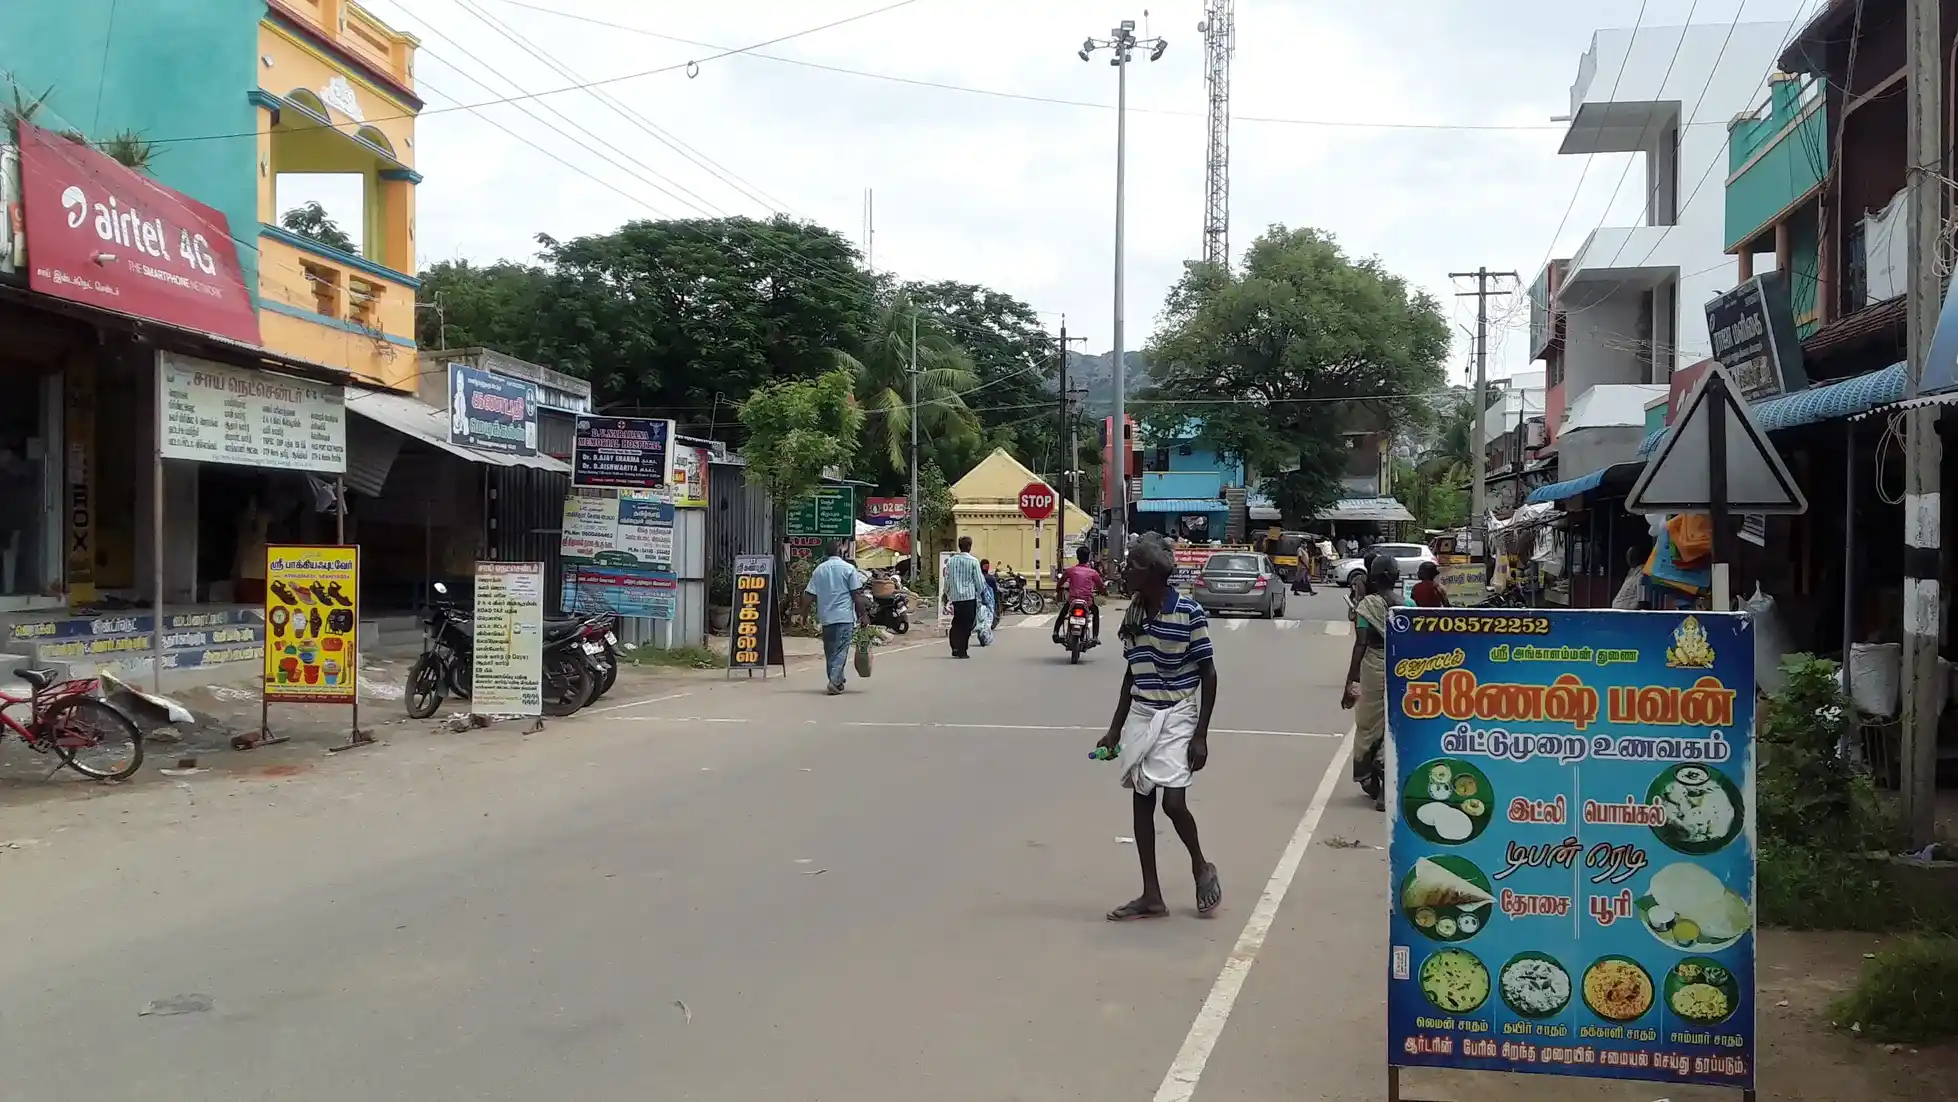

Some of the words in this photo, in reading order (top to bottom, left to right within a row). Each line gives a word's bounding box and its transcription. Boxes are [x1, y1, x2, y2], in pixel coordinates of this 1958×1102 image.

[94, 195, 171, 262] airtel
[179, 228, 217, 276] 4G
[142, 265, 190, 289] SMARTPHONE
[193, 371, 224, 392] சாய்
[228, 378, 303, 404] நெட்செண்டர்
[578, 437, 620, 449] MEMORIAL
[621, 439, 661, 450] HOSPITAL
[1021, 494, 1052, 509] STOP
[1412, 616, 1549, 634] 7708572252
[1394, 649, 1465, 679] ஹோட்டல்
[1490, 645, 1509, 662] ஸ்ரீ
[1512, 645, 1594, 662] அங்காளம்மன்
[1596, 649, 1639, 666] துணை
[1403, 669, 1599, 730] கணேஷ்
[1607, 676, 1736, 727] பவன்
[1442, 723, 1588, 765] வீட்டுமுறை
[1591, 730, 1729, 763] உணவகம்
[1508, 795, 1565, 825] இட்லி
[1584, 797, 1667, 827] பொங்கல்
[1493, 837, 1583, 880] டிபன்
[1585, 841, 1648, 883] ரெடி
[1500, 888, 1572, 919] தோசை
[1589, 888, 1633, 926] பூரி
[1416, 1016, 1454, 1030] லெமன்
[1458, 1019, 1489, 1032] சாதம்
[1503, 1020, 1532, 1035] தயிர்
[1536, 1023, 1567, 1037] சாதம்
[1580, 1024, 1623, 1039] தக்காளி
[1626, 1028, 1656, 1041] சாதம்
[1670, 1030, 1710, 1044] சாம்பார்
[1714, 1034, 1744, 1047] சாதம்
[1404, 1035, 1453, 1053] ஆர்டரின்
[1463, 1038, 1497, 1056] பேரில்
[1501, 1041, 1536, 1062] சிறந்த
[1541, 1046, 1594, 1064] முறையில்
[1600, 1049, 1649, 1067] சமையல்
[1653, 1052, 1690, 1075] செய்து
[1695, 1054, 1747, 1075] தரப்படும்.
